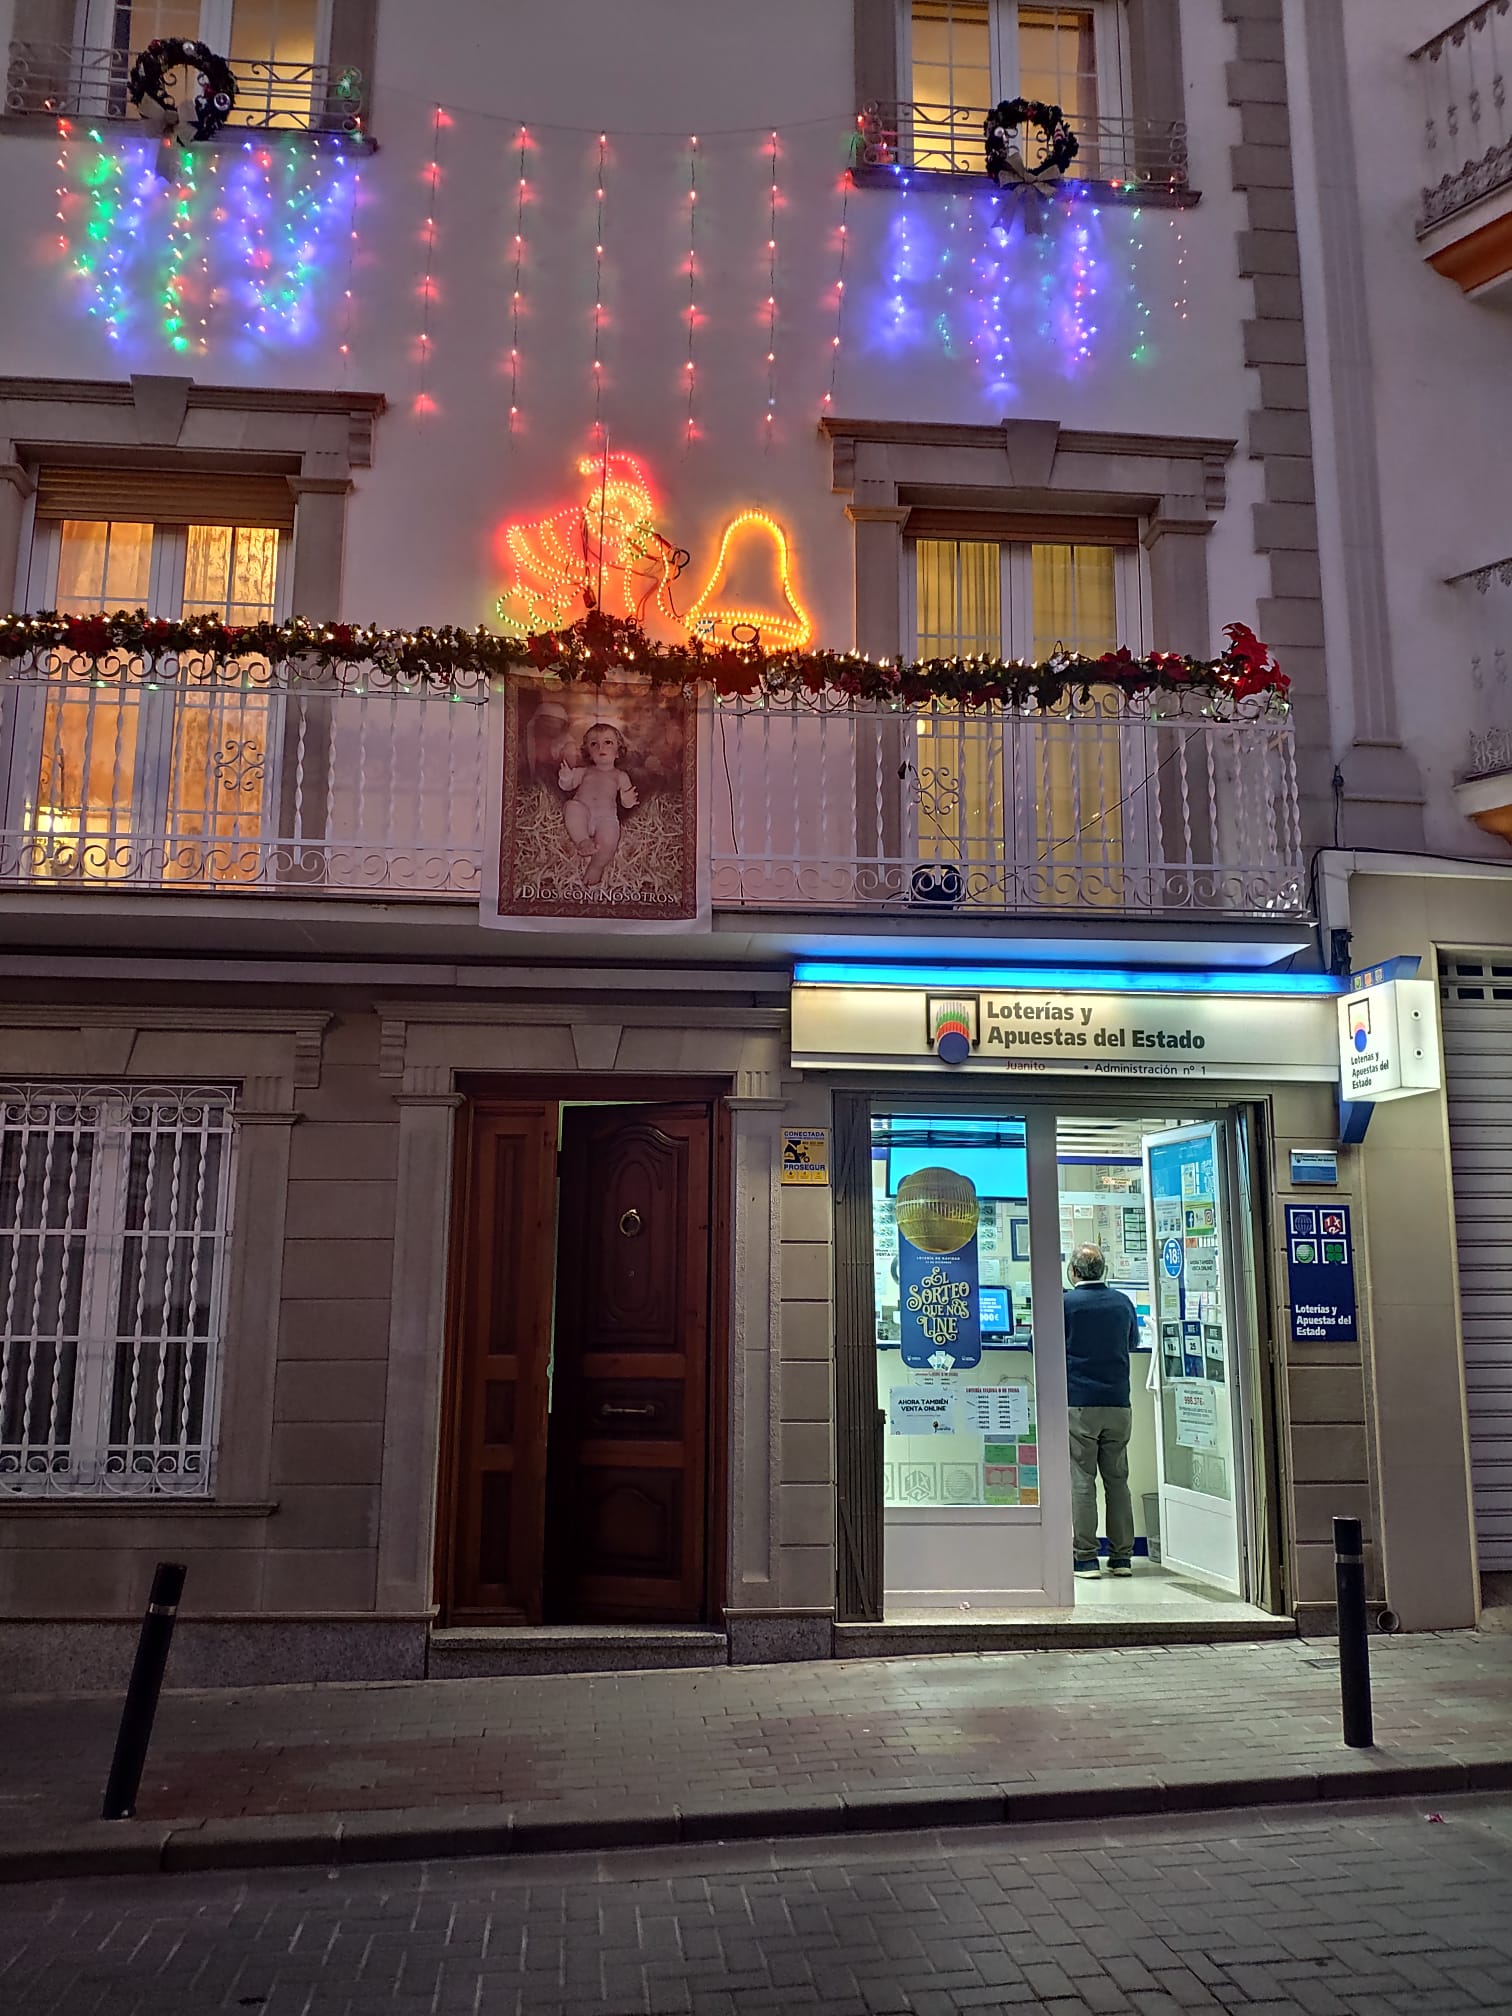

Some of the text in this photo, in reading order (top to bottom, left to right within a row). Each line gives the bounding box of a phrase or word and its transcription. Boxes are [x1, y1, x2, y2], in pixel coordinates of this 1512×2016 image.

[987, 1001, 1093, 1025] Loterías y
[987, 1026, 1205, 1049] Apuestas del Estado
[1005, 1060, 1046, 1071] Juanito
[1094, 1063, 1178, 1075] Administración
[1201, 1066, 1206, 1075] 1
[1352, 1060, 1389, 1078] Apuestas del
[1352, 1078, 1372, 1089] Estado
[921, 1266, 949, 1287] EL
[906, 1282, 970, 1311] SORTEO
[922, 1304, 944, 1317] QUE
[946, 1299, 970, 1319] NOS
[1331, 1306, 1338, 1316] y
[1296, 1315, 1352, 1327] Apuestas del
[1296, 1327, 1327, 1336] Estado
